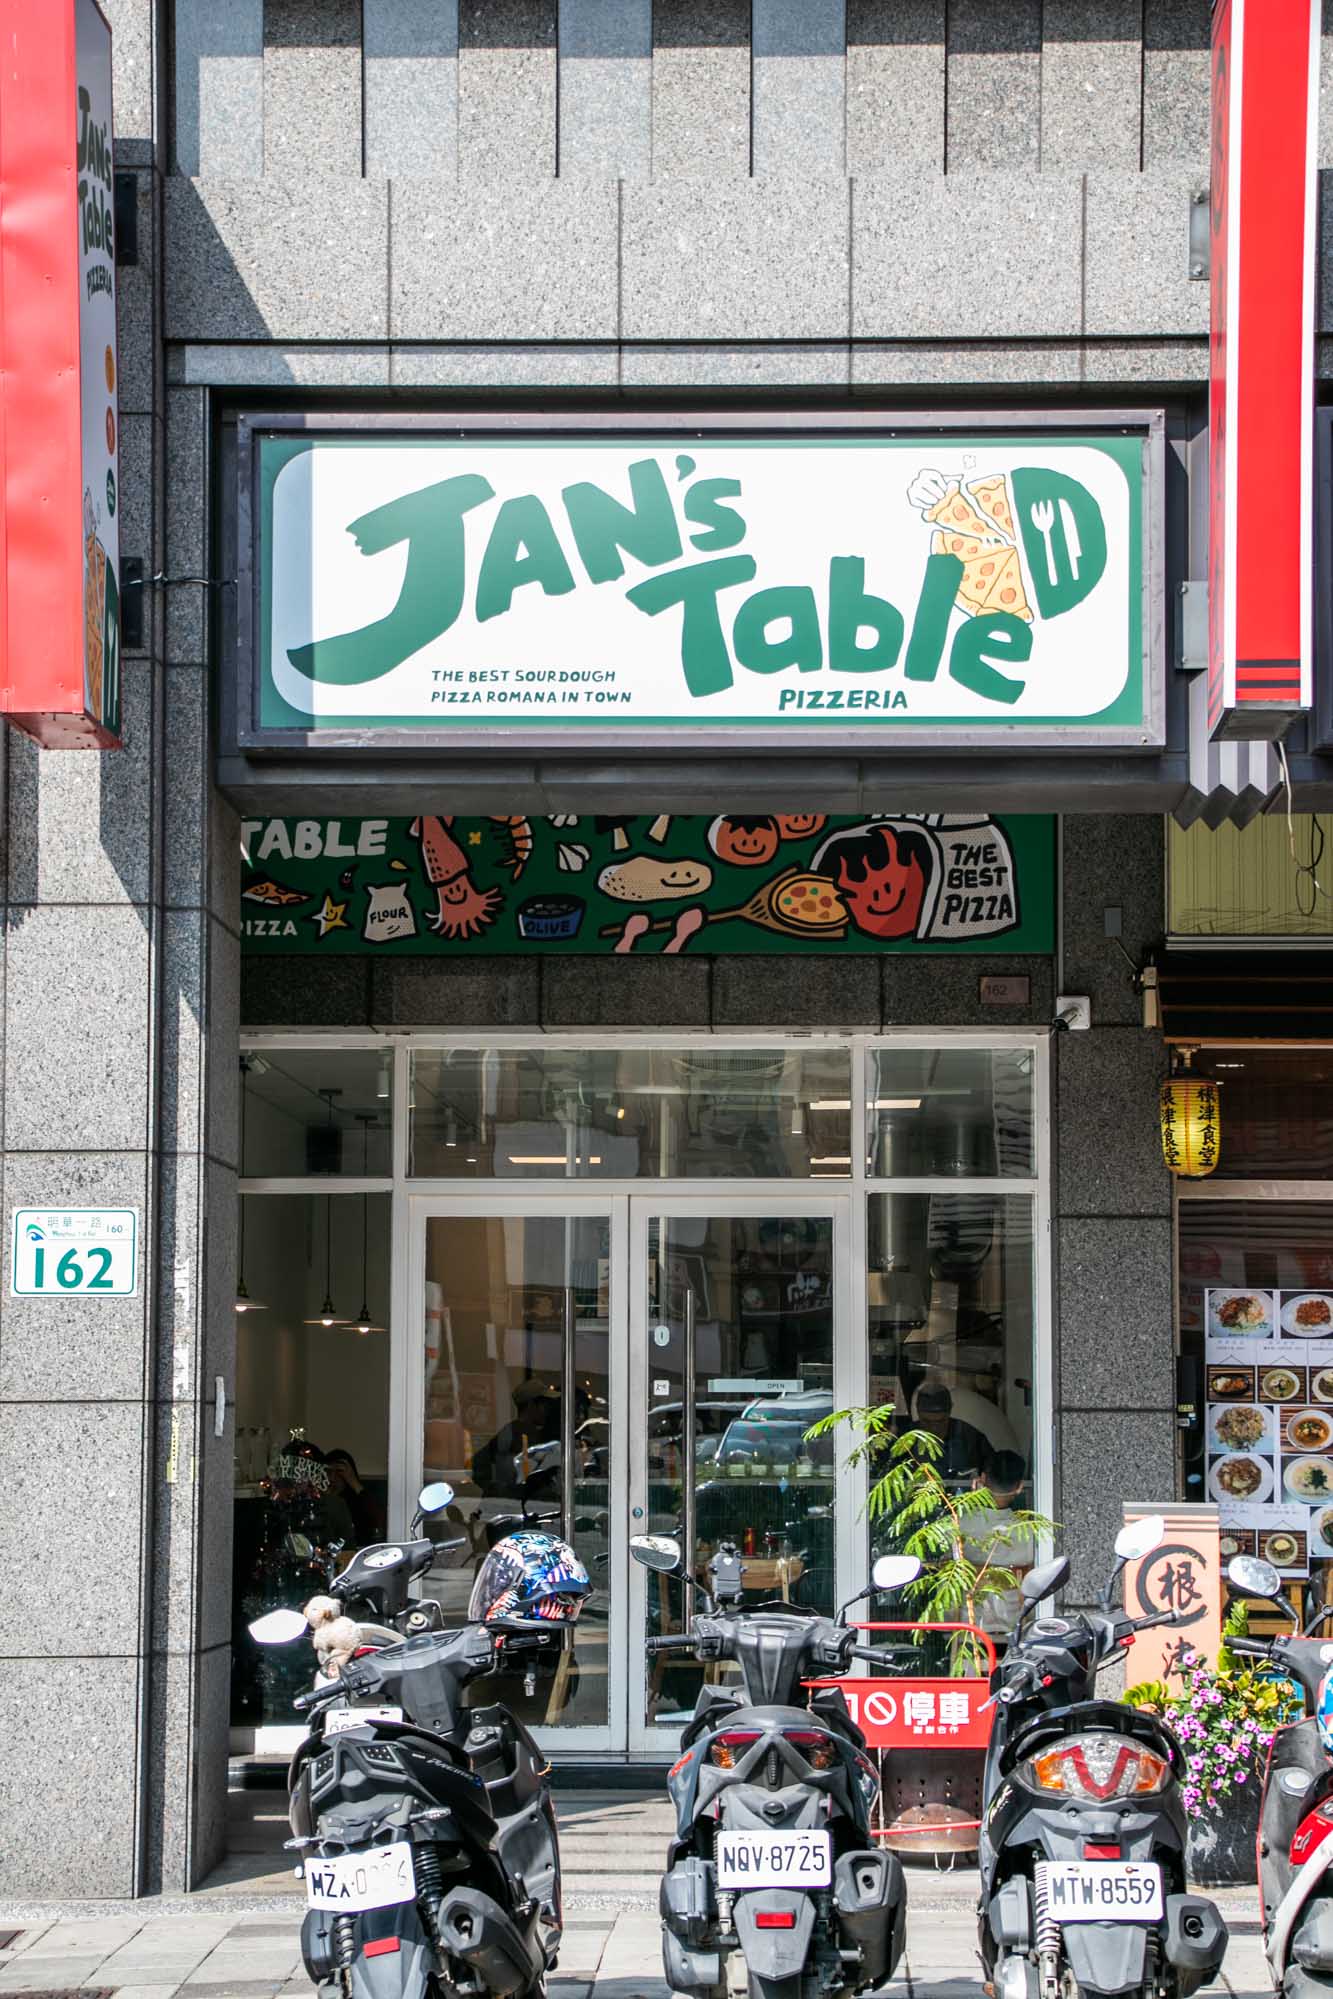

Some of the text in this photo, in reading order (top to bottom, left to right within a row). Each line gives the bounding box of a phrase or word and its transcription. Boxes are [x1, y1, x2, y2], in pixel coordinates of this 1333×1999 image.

[78, 180, 114, 259] Table
[625, 554, 1033, 704] Table
[431, 669, 616, 683] THE BEST SOURDOUGH
[431, 690, 632, 704] PIZZA ROMANA IN TOWN
[778, 688, 909, 712] PIZZERIA
[240, 818, 389, 860] TABLE
[950, 843, 999, 867] THE
[946, 866, 1009, 891] BEST
[369, 905, 408, 925] FLOUR
[941, 894, 1013, 926] PIZZA
[524, 919, 571, 935] OLIVE
[1196, 1087, 1218, 1167] 根津食堂
[34, 1247, 114, 1289] 162
[903, 1691, 970, 1726] 停車
